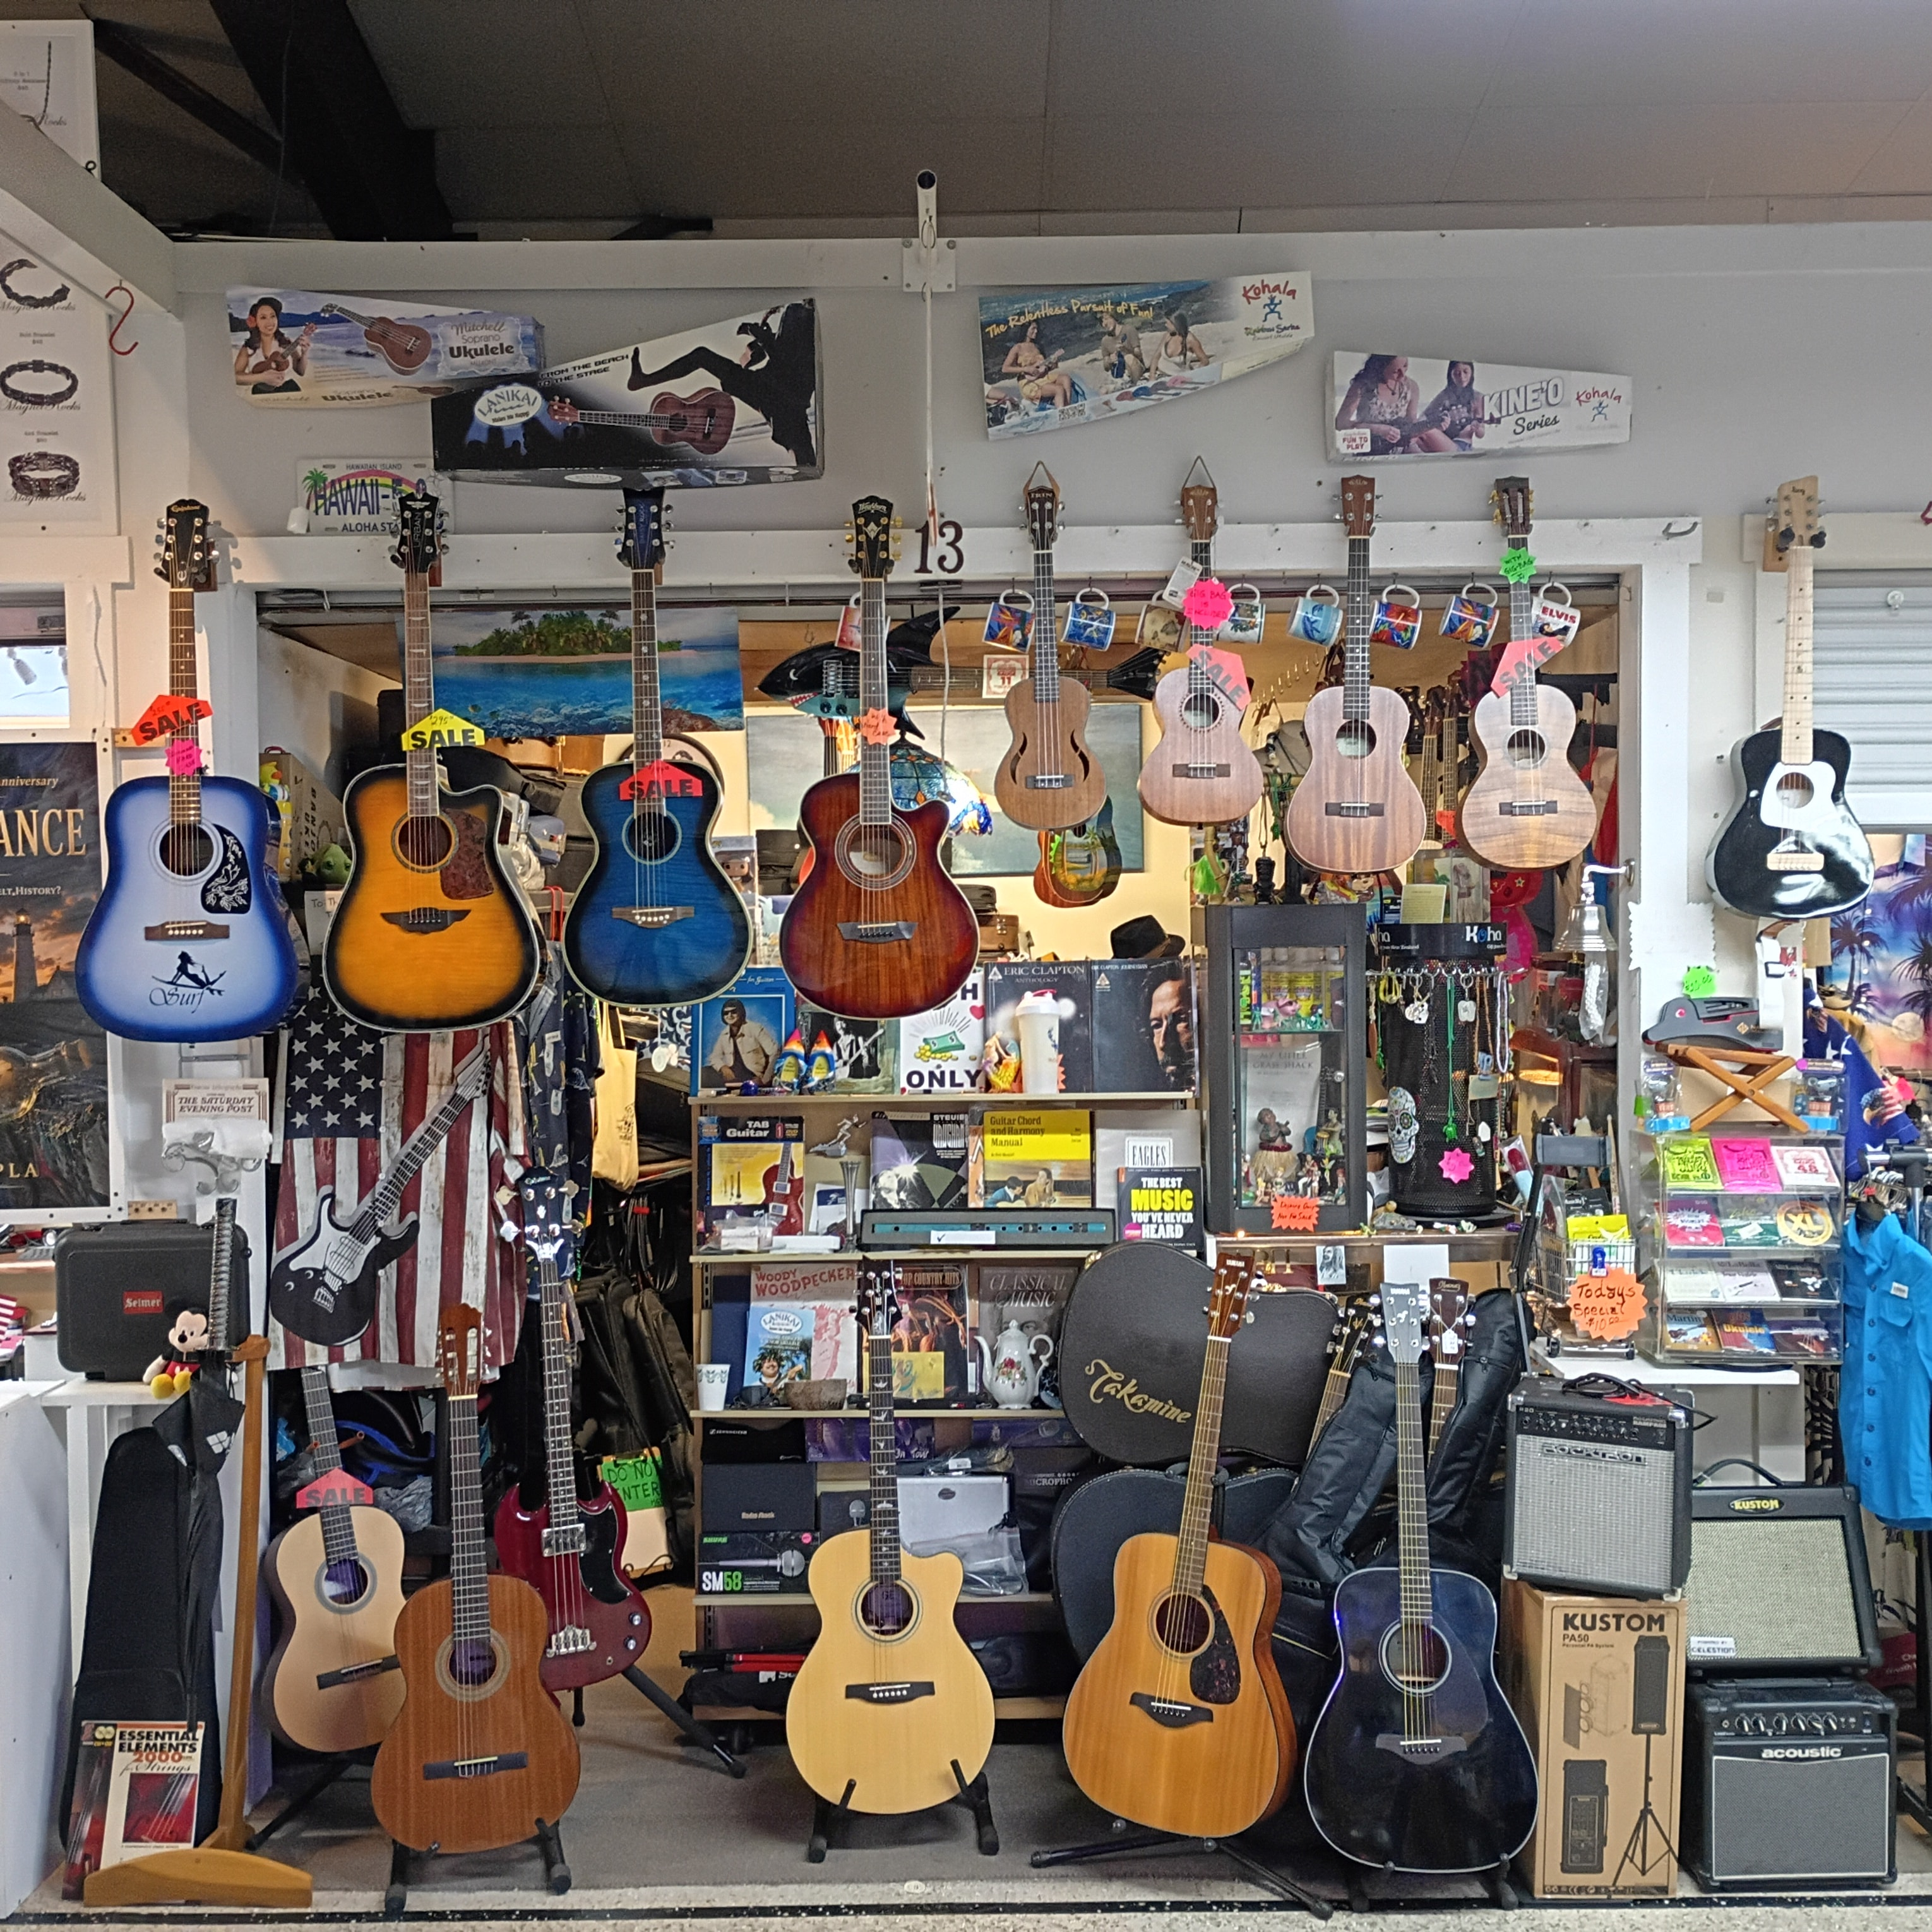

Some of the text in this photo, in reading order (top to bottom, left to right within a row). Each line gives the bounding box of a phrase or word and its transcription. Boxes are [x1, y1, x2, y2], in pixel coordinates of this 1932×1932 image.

[1241, 280, 1296, 304] Kohala
[986, 299, 1154, 339] The Relentless Pursuit of Fun!
[451, 320, 506, 335] Mitchell
[462, 333, 501, 345] Soprano
[449, 343, 515, 359] Ukulele
[540, 354, 628, 378] FROM THE BEACH
[553, 375, 573, 385] THE
[576, 366, 610, 378] STAGE
[321, 391, 393, 402] Ukulele
[478, 390, 537, 417] LANIKAI
[1482, 377, 1564, 420] KINE'O
[1576, 386, 1621, 405] Kohala
[1513, 413, 1559, 436] Series
[342, 523, 399, 532] ALOHA STA
[914, 520, 964, 574] 13
[1210, 591, 1227, 599] BAG
[1541, 606, 1577, 624] ELVIS
[1500, 641, 1556, 690] SALE
[1193, 650, 1246, 703] SALE
[140, 702, 205, 741] SALE
[411, 729, 477, 749] SALE
[0, 776, 58, 788] nniversary
[628, 779, 693, 799] SALE
[1465, 925, 1502, 943] Koha
[1005, 965, 1085, 975] ERIC CLAPTON
[149, 987, 205, 1014] Surf
[907, 1070, 982, 1088] ONLY
[201, 1096, 254, 1104] SATURDAY
[990, 1116, 1041, 1125] Guitar Chord
[726, 1129, 769, 1137] Guitar
[991, 1126, 1045, 1136] and Harmony
[991, 1138, 1023, 1147] Manual
[1133, 1145, 1166, 1166] EAGLES
[0, 1162, 39, 1178] LA
[1141, 1178, 1183, 1188] THE BEST
[1131, 1190, 1193, 1211] MUSIC
[1131, 1212, 1194, 1224] YOU'VE NEVER
[1786, 1212, 1824, 1231] XL
[1142, 1224, 1184, 1239] HEARD
[755, 1268, 797, 1282] WOODY
[755, 1267, 856, 1296] WOODPECKER
[914, 1273, 943, 1285] COUNTRY
[945, 1273, 960, 1285] HITS
[989, 1274, 1067, 1291] CLASSICAL
[996, 1291, 1056, 1308] MUSIC
[1577, 1279, 1636, 1304] Todays
[125, 1297, 161, 1308] Selmer
[1573, 1301, 1626, 1318] Special
[763, 1313, 800, 1327] LANIKAI
[1666, 1314, 1701, 1323] Martin
[1723, 1323, 1765, 1334] Ukulele
[1085, 1359, 1191, 1423] Takamine
[910, 1447, 929, 1459] Tour
[607, 1461, 653, 1484] DO NO
[306, 1488, 365, 1507] SALE
[617, 1481, 660, 1501] NTER
[1734, 1499, 1779, 1510] KUSTOM
[702, 1571, 742, 1591] SM58
[1563, 1613, 1665, 1632] KUSTOM
[1563, 1633, 1589, 1642] PA50
[1691, 1646, 1735, 1654] CELESTION
[118, 1730, 199, 1741] ESSENTIAL
[118, 1742, 197, 1753] ELEMENTS
[1762, 1746, 1842, 1759] acoustic
[132, 1751, 182, 1763] 2000
[135, 1761, 191, 1772] Strings
